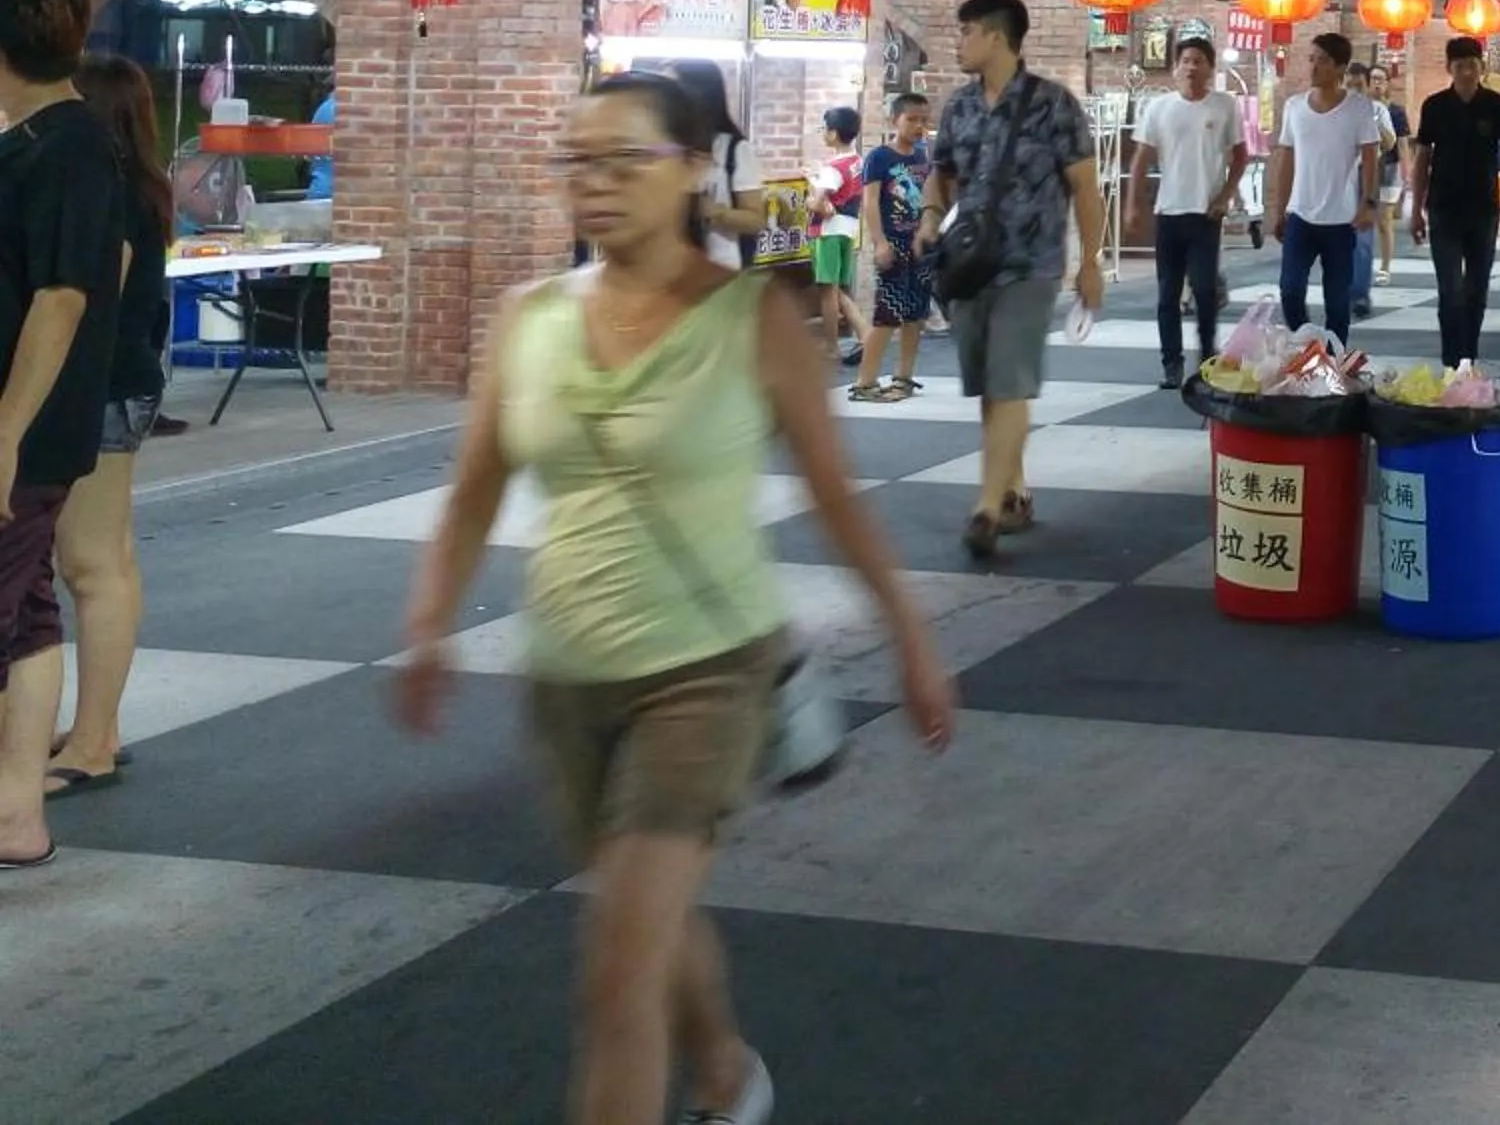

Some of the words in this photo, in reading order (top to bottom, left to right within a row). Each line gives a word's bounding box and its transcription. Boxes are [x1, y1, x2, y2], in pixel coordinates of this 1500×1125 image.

[1219, 467, 1297, 504] 收集桶
[1219, 525, 1295, 572] 垃圾
[1381, 532, 1422, 580] 源
